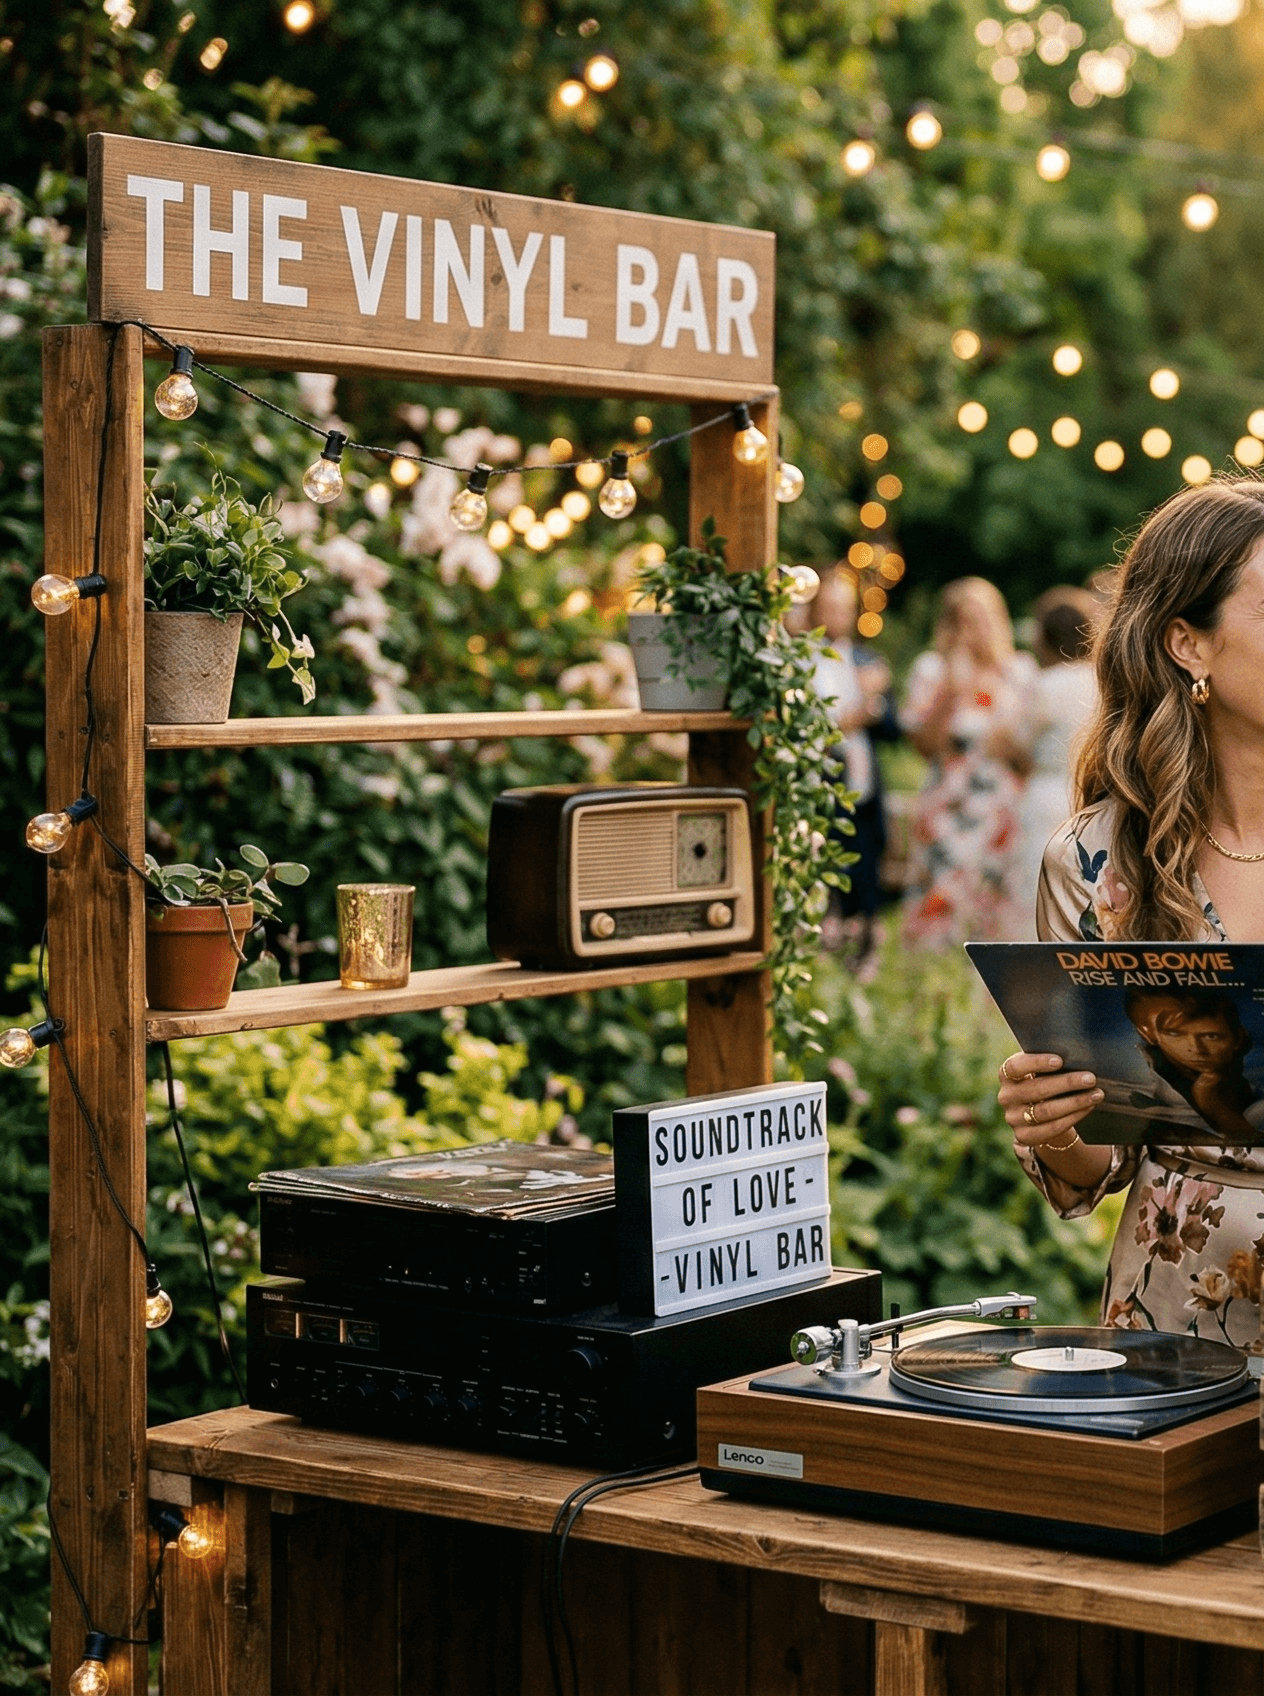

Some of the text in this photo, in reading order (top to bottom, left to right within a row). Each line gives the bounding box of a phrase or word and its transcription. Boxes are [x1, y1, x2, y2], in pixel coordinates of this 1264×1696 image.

[127, 174, 759, 358] THE VINYL BAR
[1056, 952, 1234, 970] DAVID BOWIE
[1069, 971, 1118, 986] RISE
[1123, 971, 1171, 987] AND
[655, 1098, 823, 1166] SOUNDTRACK
[682, 1183, 713, 1227] OF
[777, 1224, 824, 1271] BAR
[724, 1449, 764, 1465] Lenco
